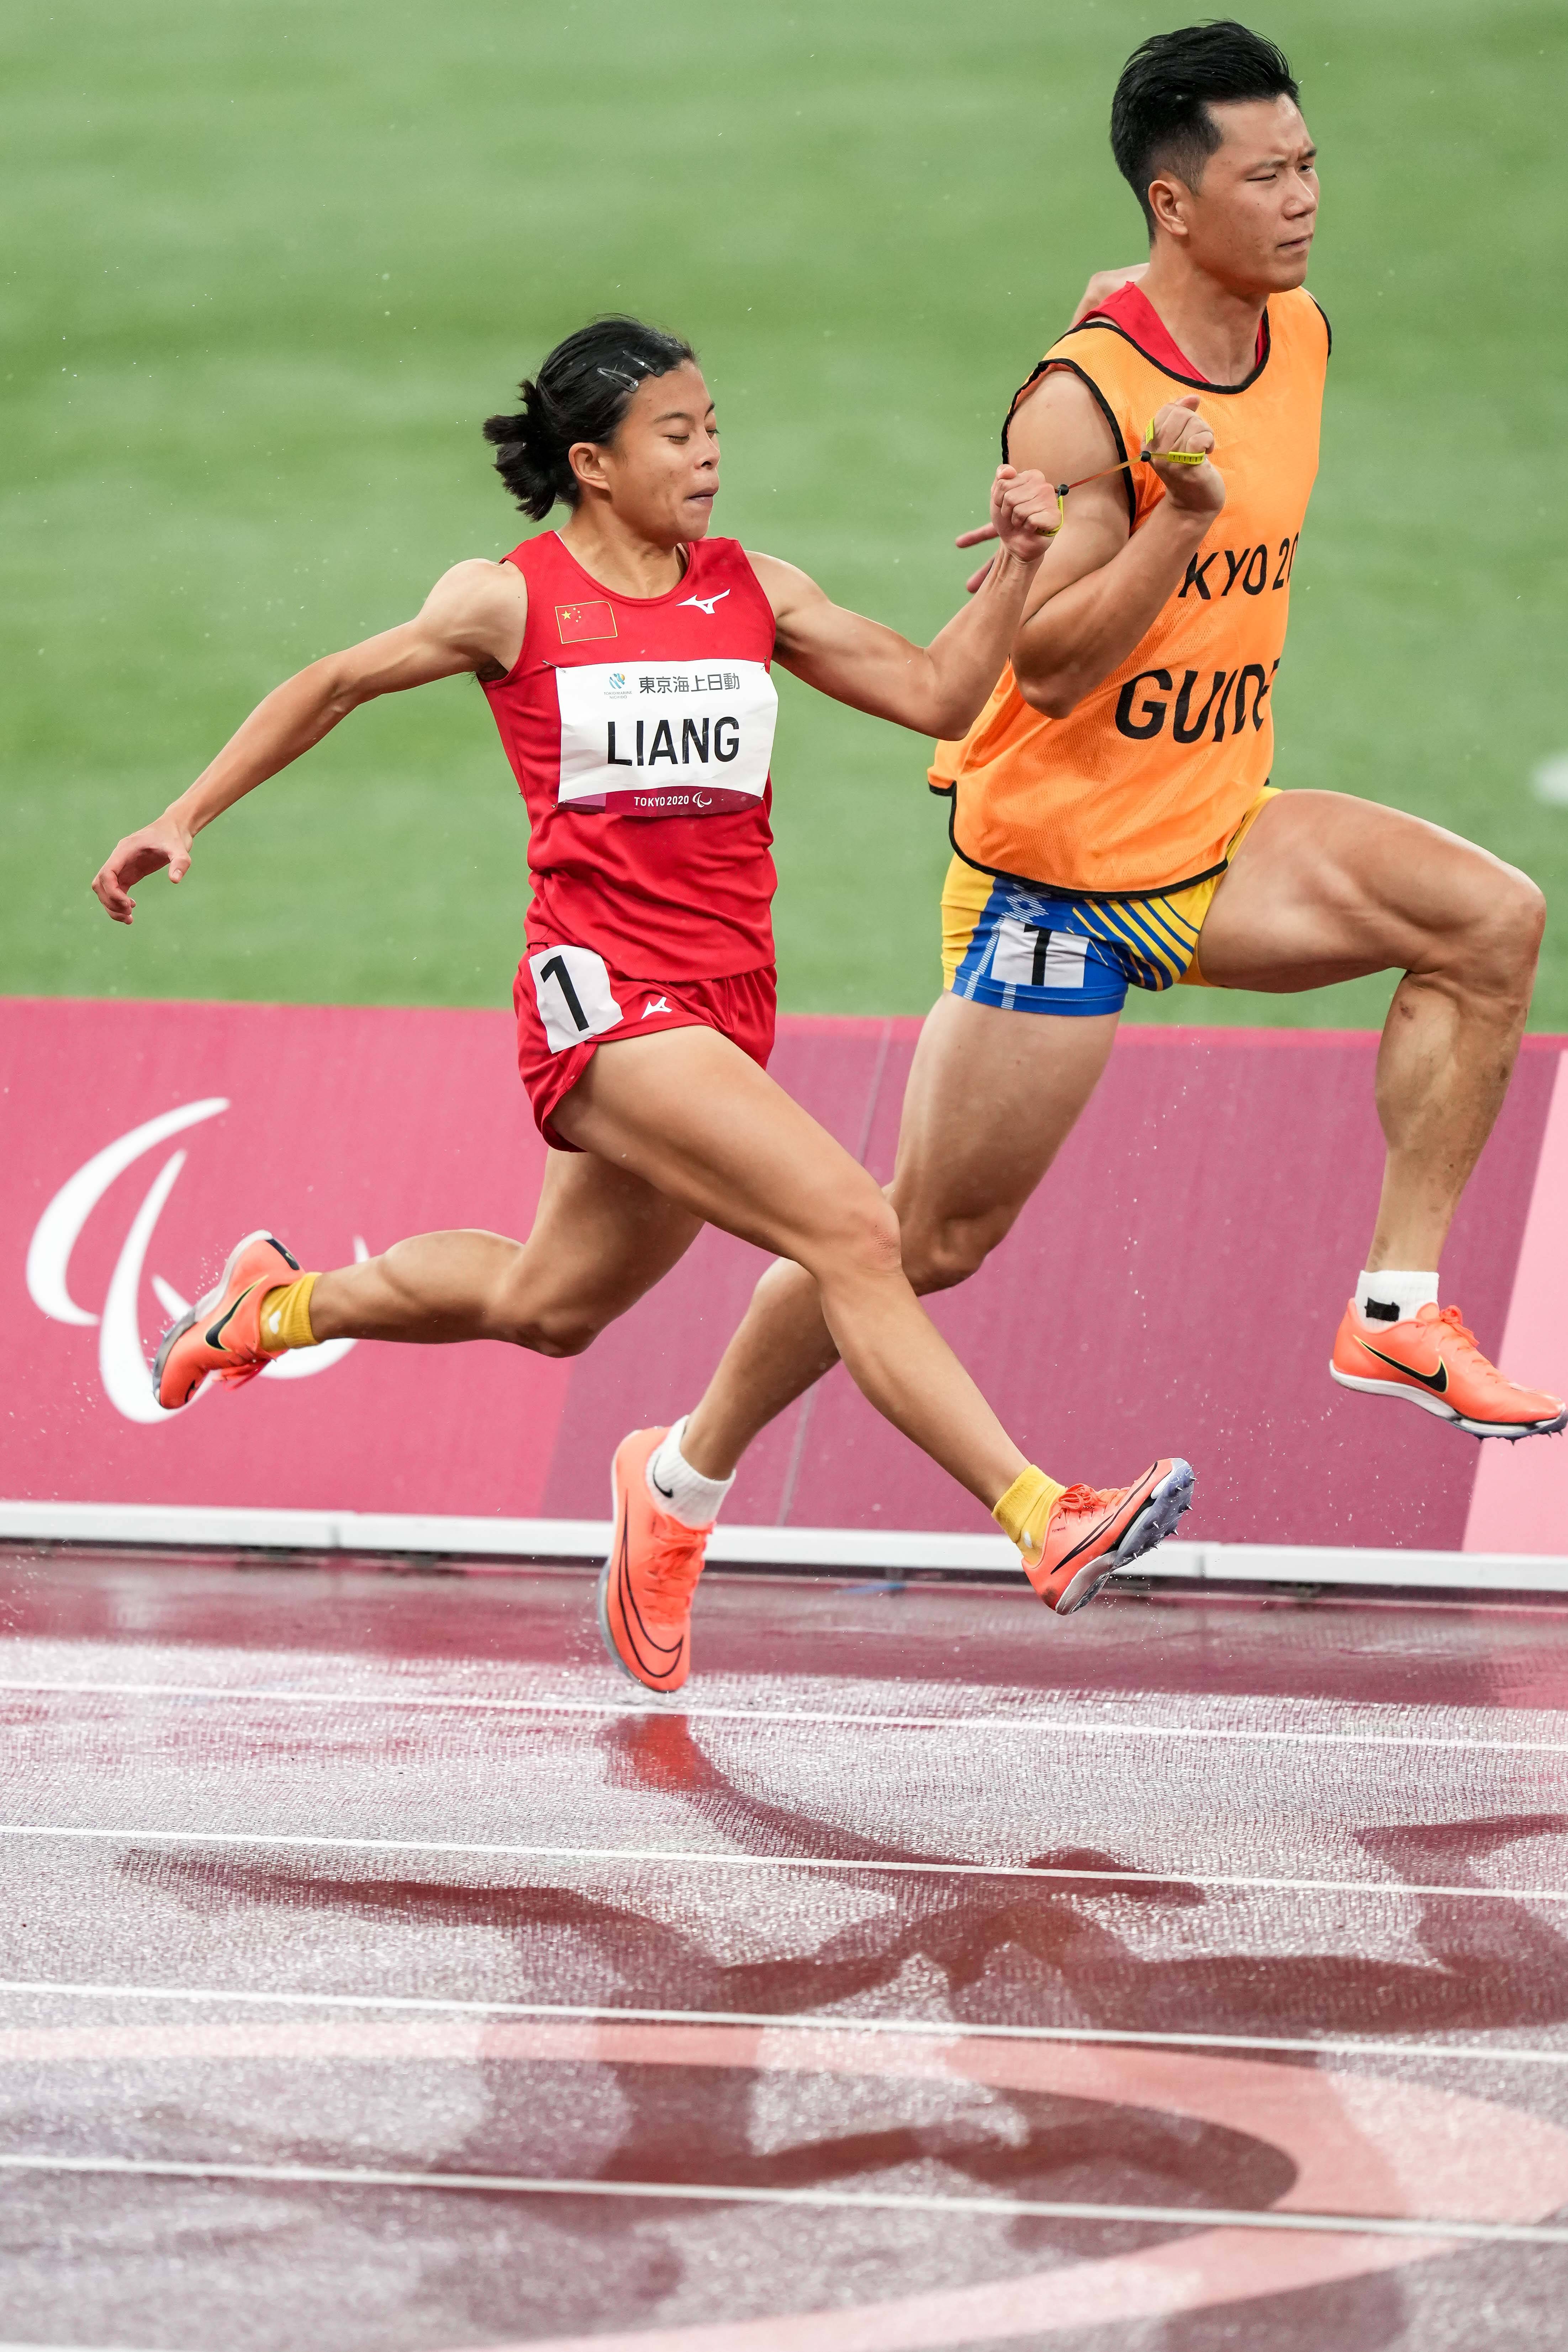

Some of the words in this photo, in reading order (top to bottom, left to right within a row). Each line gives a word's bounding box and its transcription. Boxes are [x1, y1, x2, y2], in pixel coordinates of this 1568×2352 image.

[1178, 544, 1267, 599] KYO
[1272, 532, 1299, 590] 20
[639, 673, 740, 693] 東京海上日動
[608, 717, 739, 766] LIANG
[634, 797, 665, 807] TOKYO
[667, 795, 689, 805] 2020
[540, 955, 590, 1032] 1
